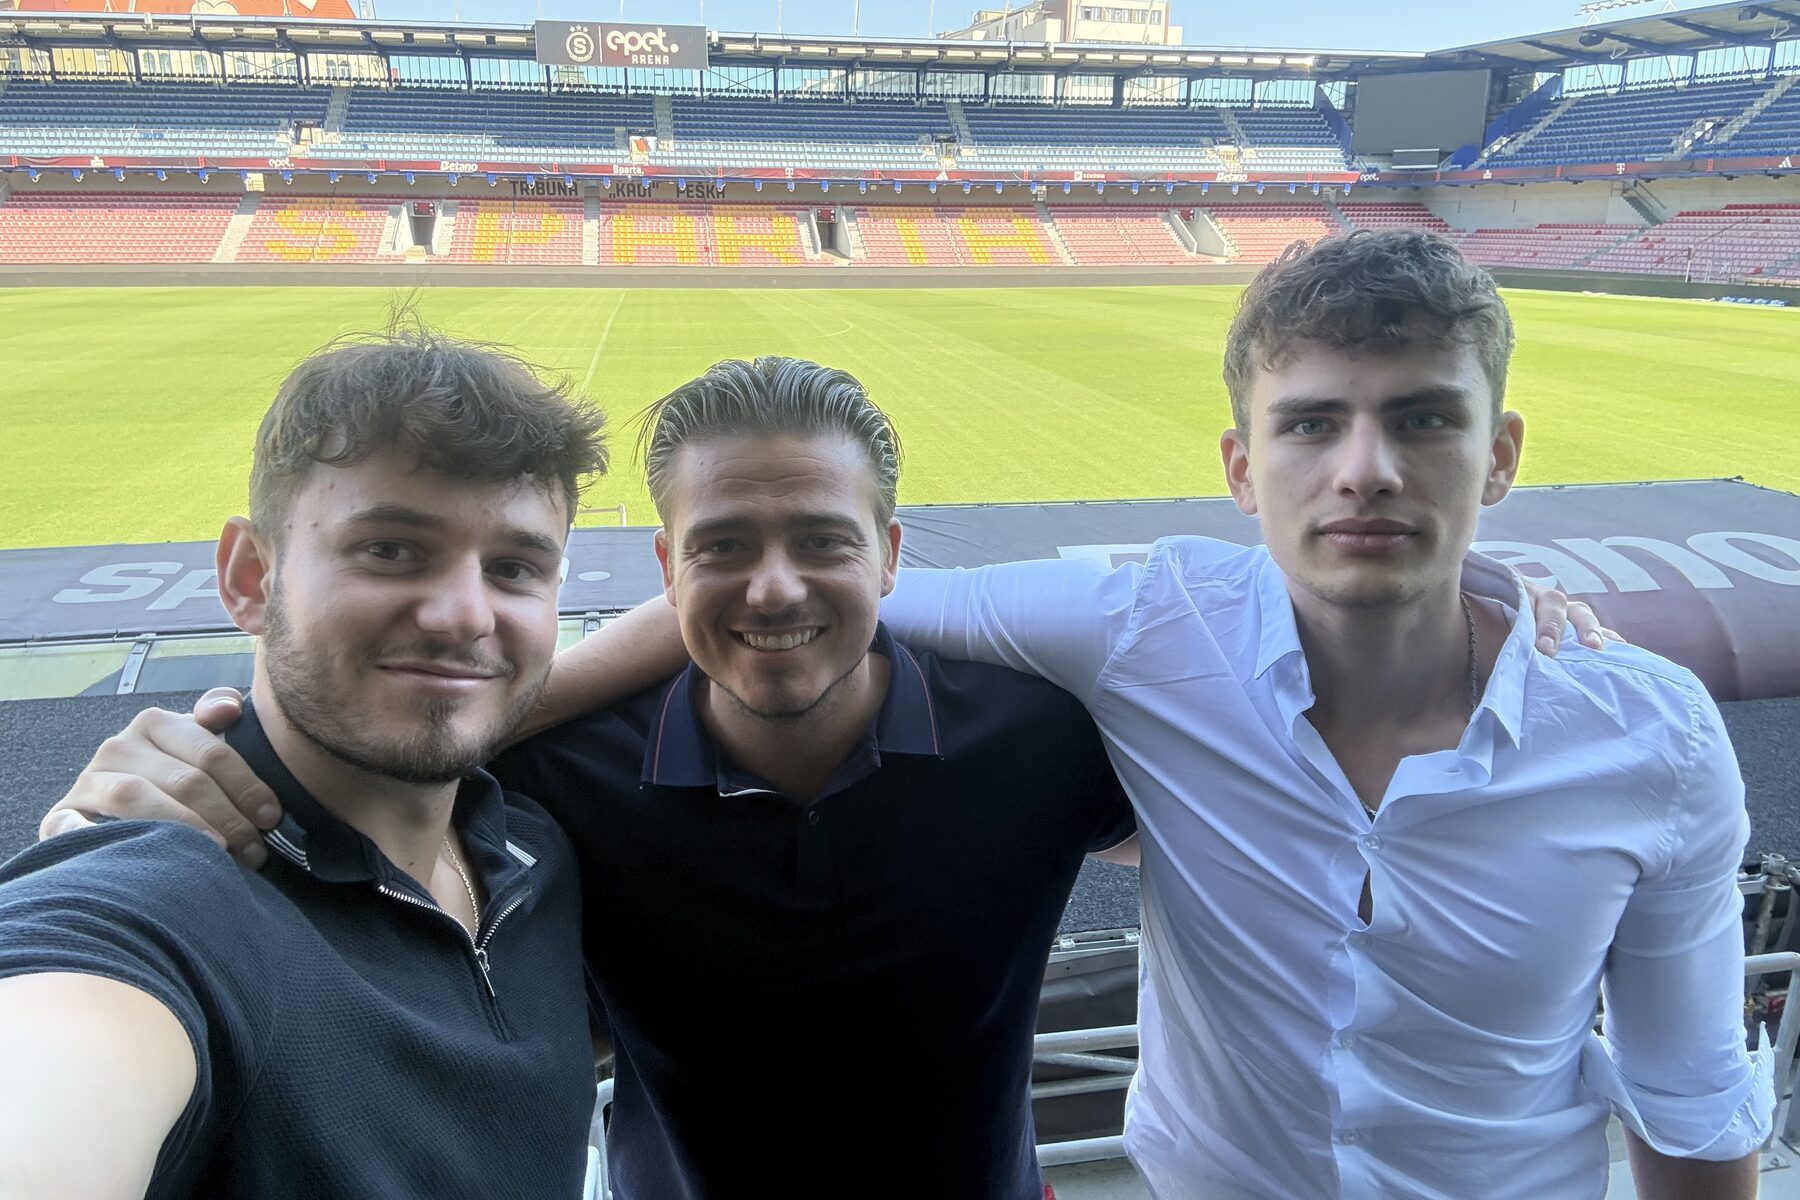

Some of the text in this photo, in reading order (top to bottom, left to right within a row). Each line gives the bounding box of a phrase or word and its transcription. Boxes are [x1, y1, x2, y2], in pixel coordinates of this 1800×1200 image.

[631, 54, 670, 66] ARENA
[440, 160, 479, 172] Betano
[1215, 172, 1249, 183] Betano
[509, 181, 578, 197] TRIBUNA
